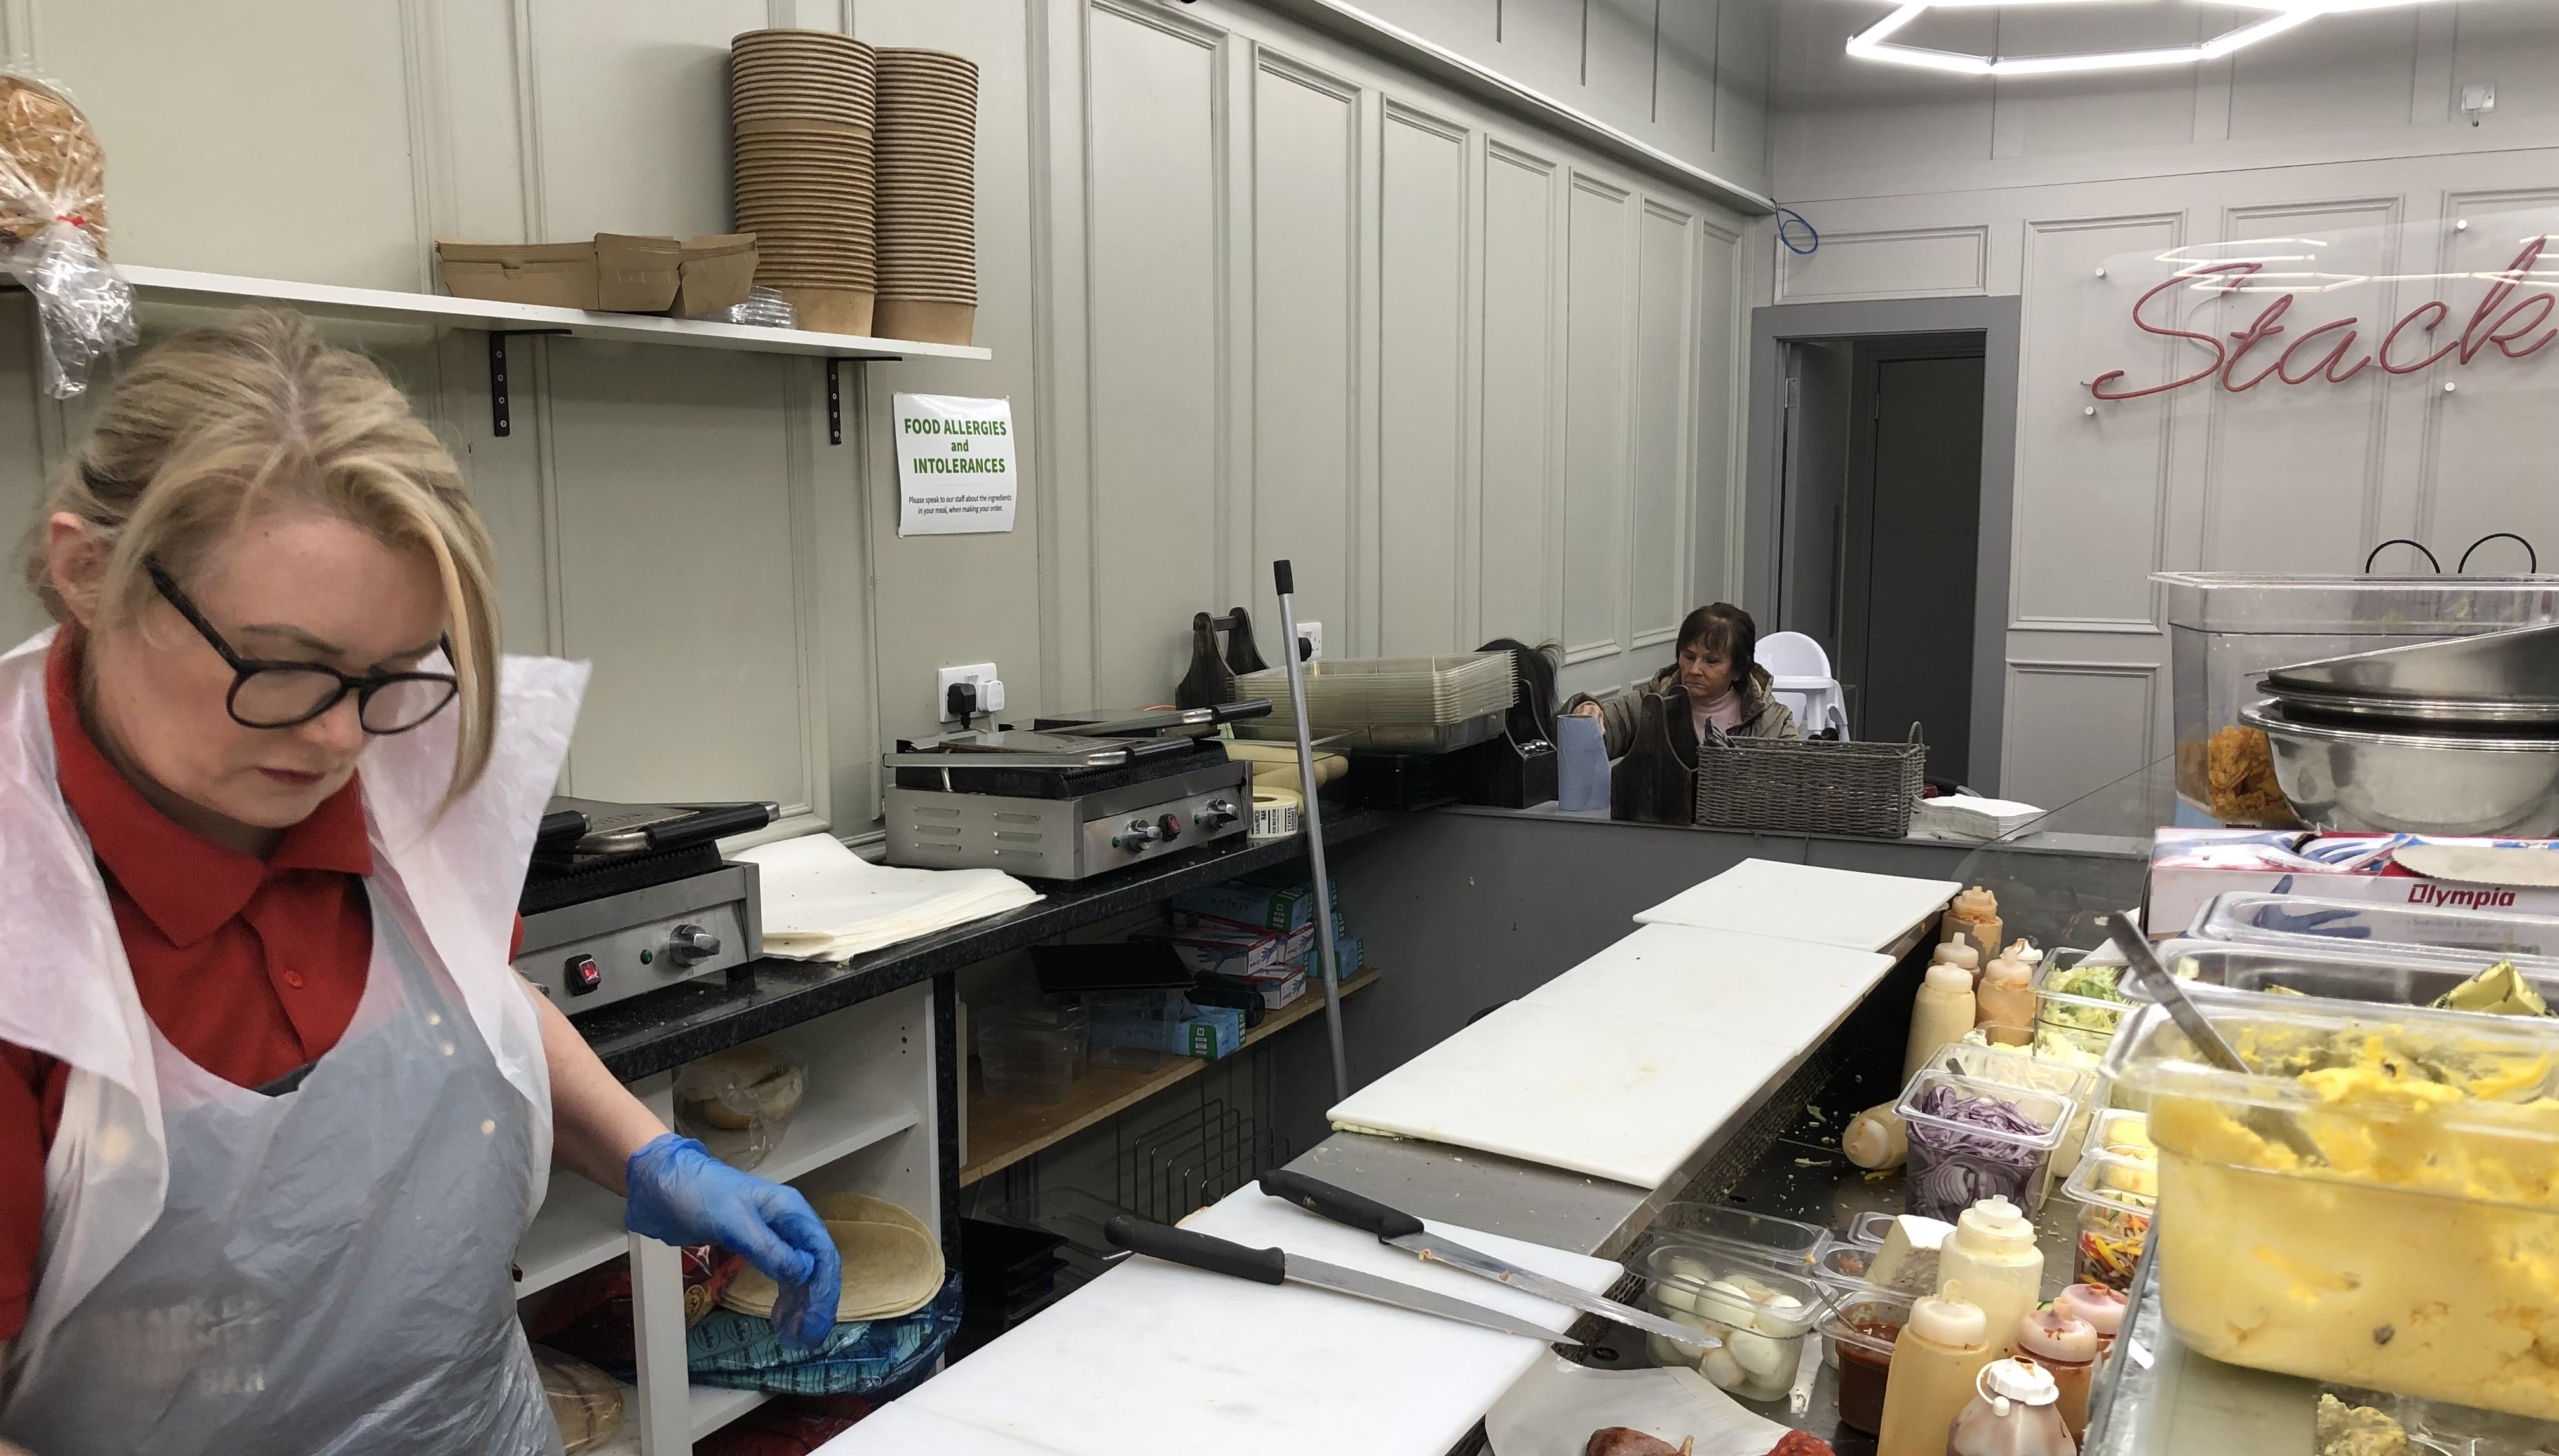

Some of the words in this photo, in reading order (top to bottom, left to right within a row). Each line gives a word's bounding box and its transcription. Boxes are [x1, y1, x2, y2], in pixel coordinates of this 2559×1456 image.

[2091, 233, 2558, 400] Stack
[904, 418, 941, 435] FOOD
[944, 419, 1006, 436] ALLERGIES
[951, 439, 969, 452] and
[914, 457, 1006, 474] INTOLERANCES
[925, 495, 939, 504] speak
[987, 494, 1012, 503] ingredients
[923, 508, 934, 516] your
[935, 506, 948, 515] meal,
[962, 506, 979, 514] making
[2408, 884, 2516, 910] Olympia
